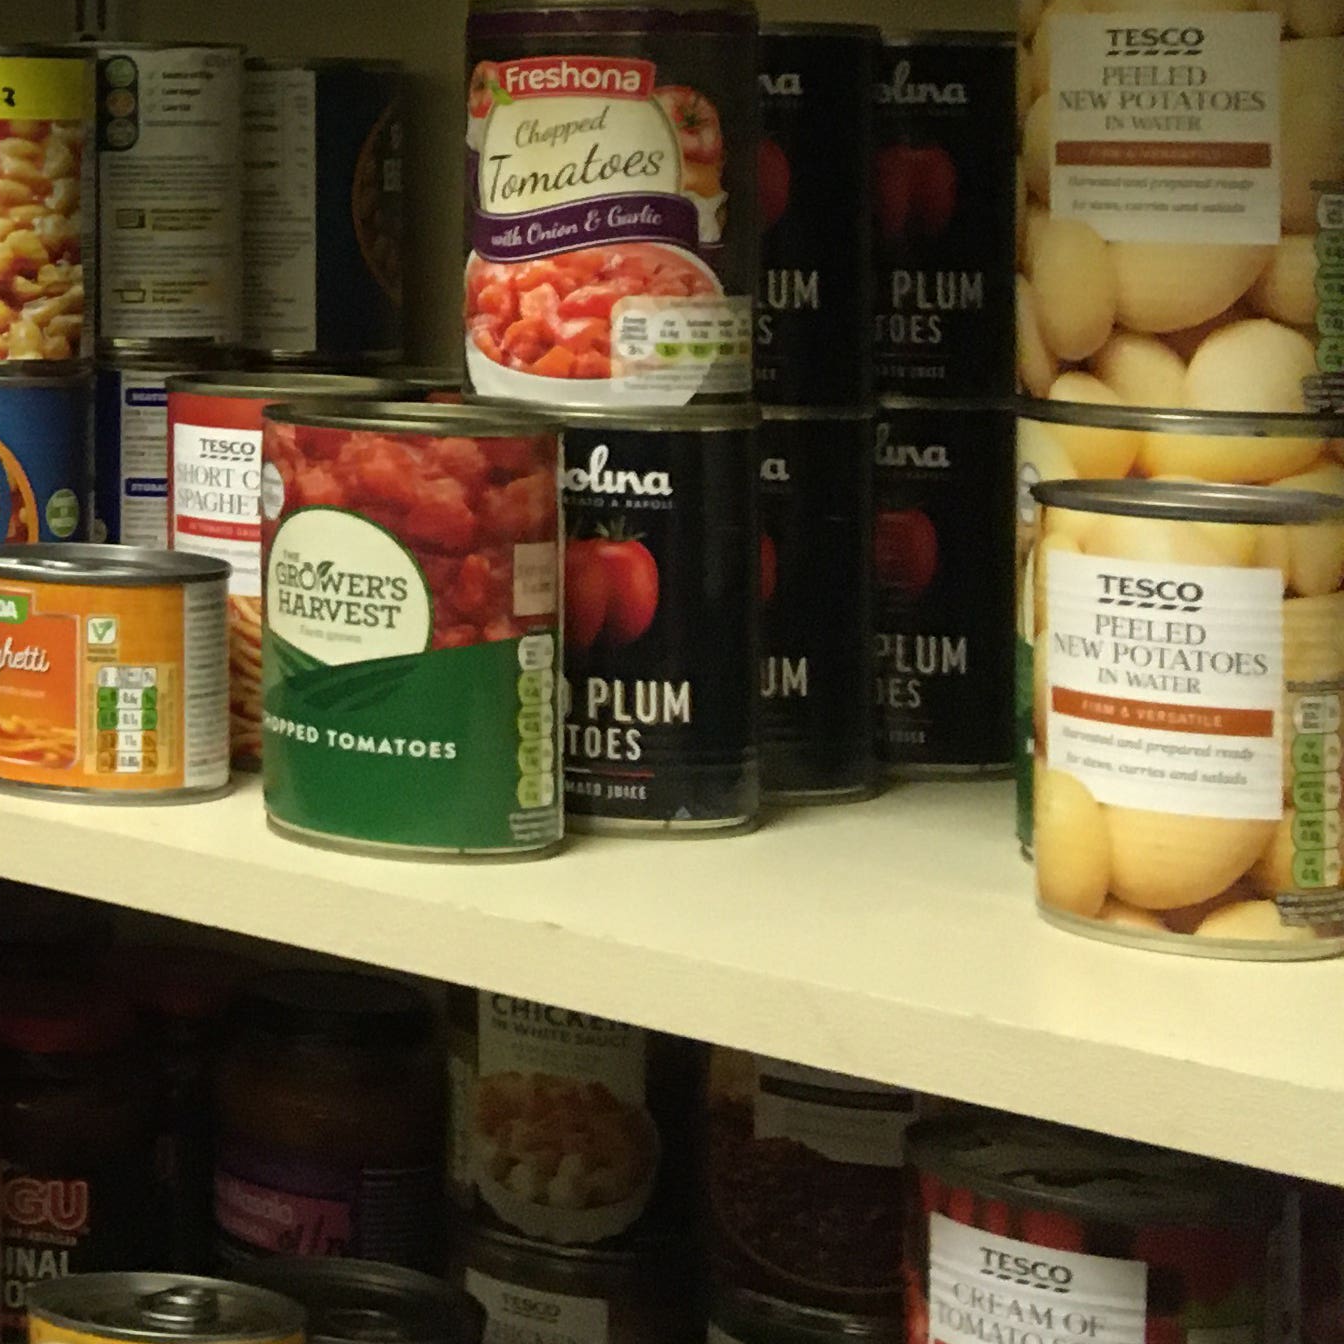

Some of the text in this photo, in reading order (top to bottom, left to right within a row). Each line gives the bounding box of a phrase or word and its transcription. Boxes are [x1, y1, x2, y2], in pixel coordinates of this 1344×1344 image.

[1105, 26, 1205, 48] TESCO
[505, 61, 642, 94] Freshona
[1102, 64, 1208, 88] PEELED
[1057, 89, 1267, 113] NEW POTATOES
[514, 105, 610, 149] Chopped
[1105, 114, 1202, 133] IN WATER
[488, 143, 665, 205] Tomatoes
[491, 203, 664, 248] with Onion & Garlic
[891, 269, 985, 311] PLUM
[198, 437, 256, 456] TESCO
[177, 463, 236, 488] SHORT
[276, 560, 409, 602] GROWER'S
[1097, 573, 1204, 603] TESCO
[278, 588, 402, 630] HARVEST
[1094, 612, 1207, 646] PEELED
[1053, 631, 1269, 677] NEW POTATOES
[1098, 668, 1202, 696] IN WATER
[587, 677, 692, 723] PLUM
[1138, 707, 1224, 729] VERSATILE
[326, 729, 458, 760] TOMATOES
[1115, 732, 1144, 750] and
[1145, 737, 1211, 759] prepared
[1117, 762, 1248, 788] curries and salads
[4, 1177, 89, 1231] GU
[979, 1245, 1074, 1286] TESCO
[502, 1293, 562, 1319] TESCO
[951, 1279, 1109, 1338] CREAM OF
